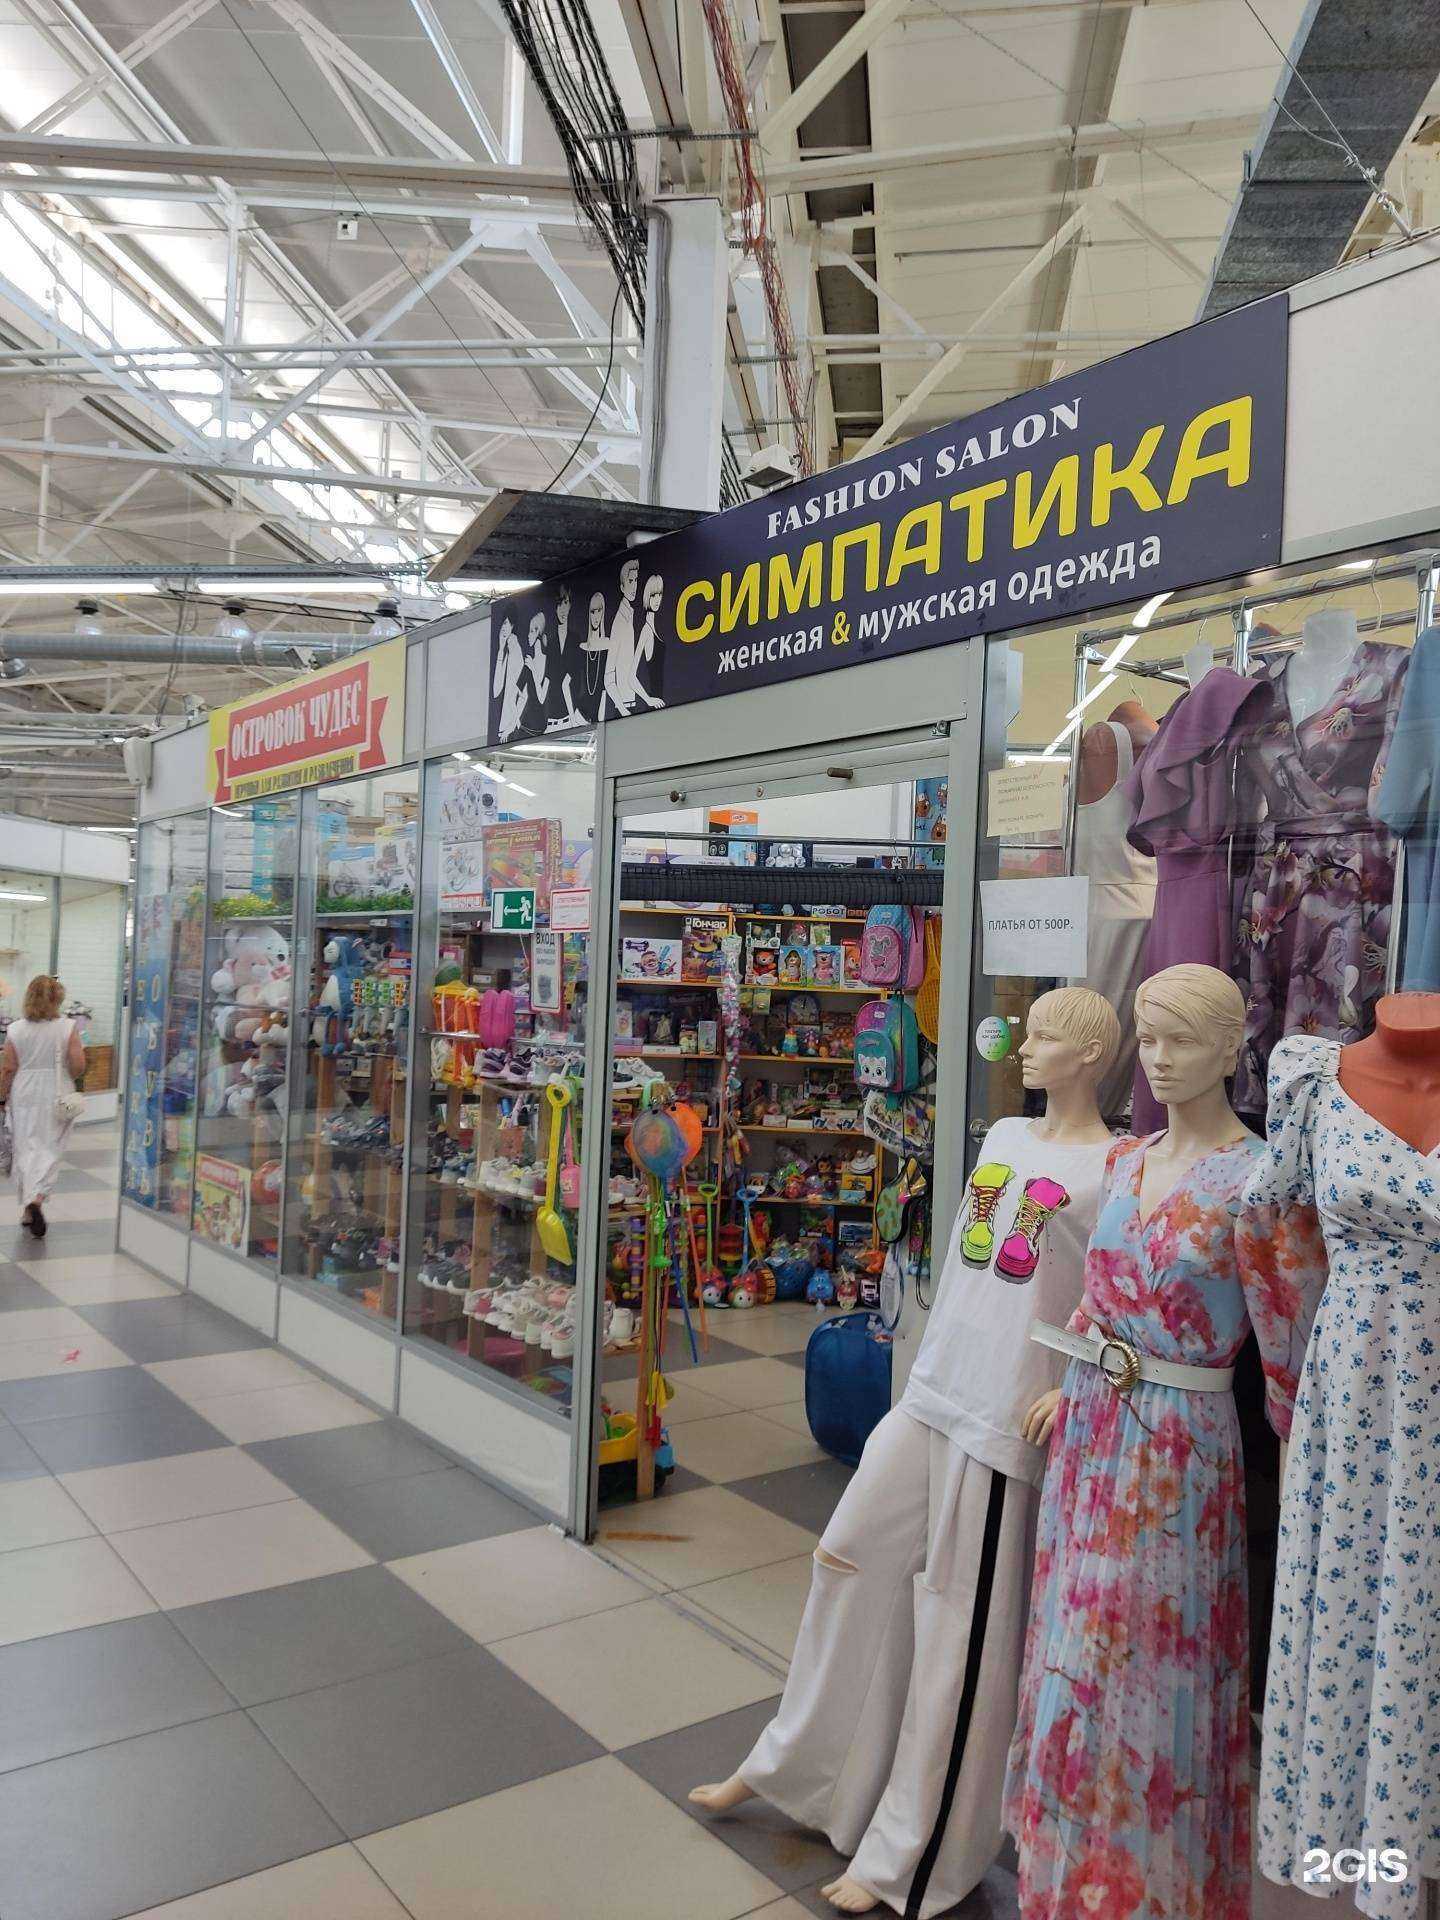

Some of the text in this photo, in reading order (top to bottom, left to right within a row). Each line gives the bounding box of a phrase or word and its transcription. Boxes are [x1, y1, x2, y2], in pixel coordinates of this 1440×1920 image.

[766, 396, 1086, 540] FASHION SALON
[676, 395, 1254, 644] СИМПАТИКА
[717, 534, 1162, 675] женская & мужская одежда
[231, 681, 361, 761] ОСТРОВОК ЧУДЕС
[536, 932, 555, 946] ВХОД
[692, 917, 727, 930] Гончар
[988, 919, 1026, 932] ПЛАТЬЯ
[1028, 919, 1043, 931] ОТ
